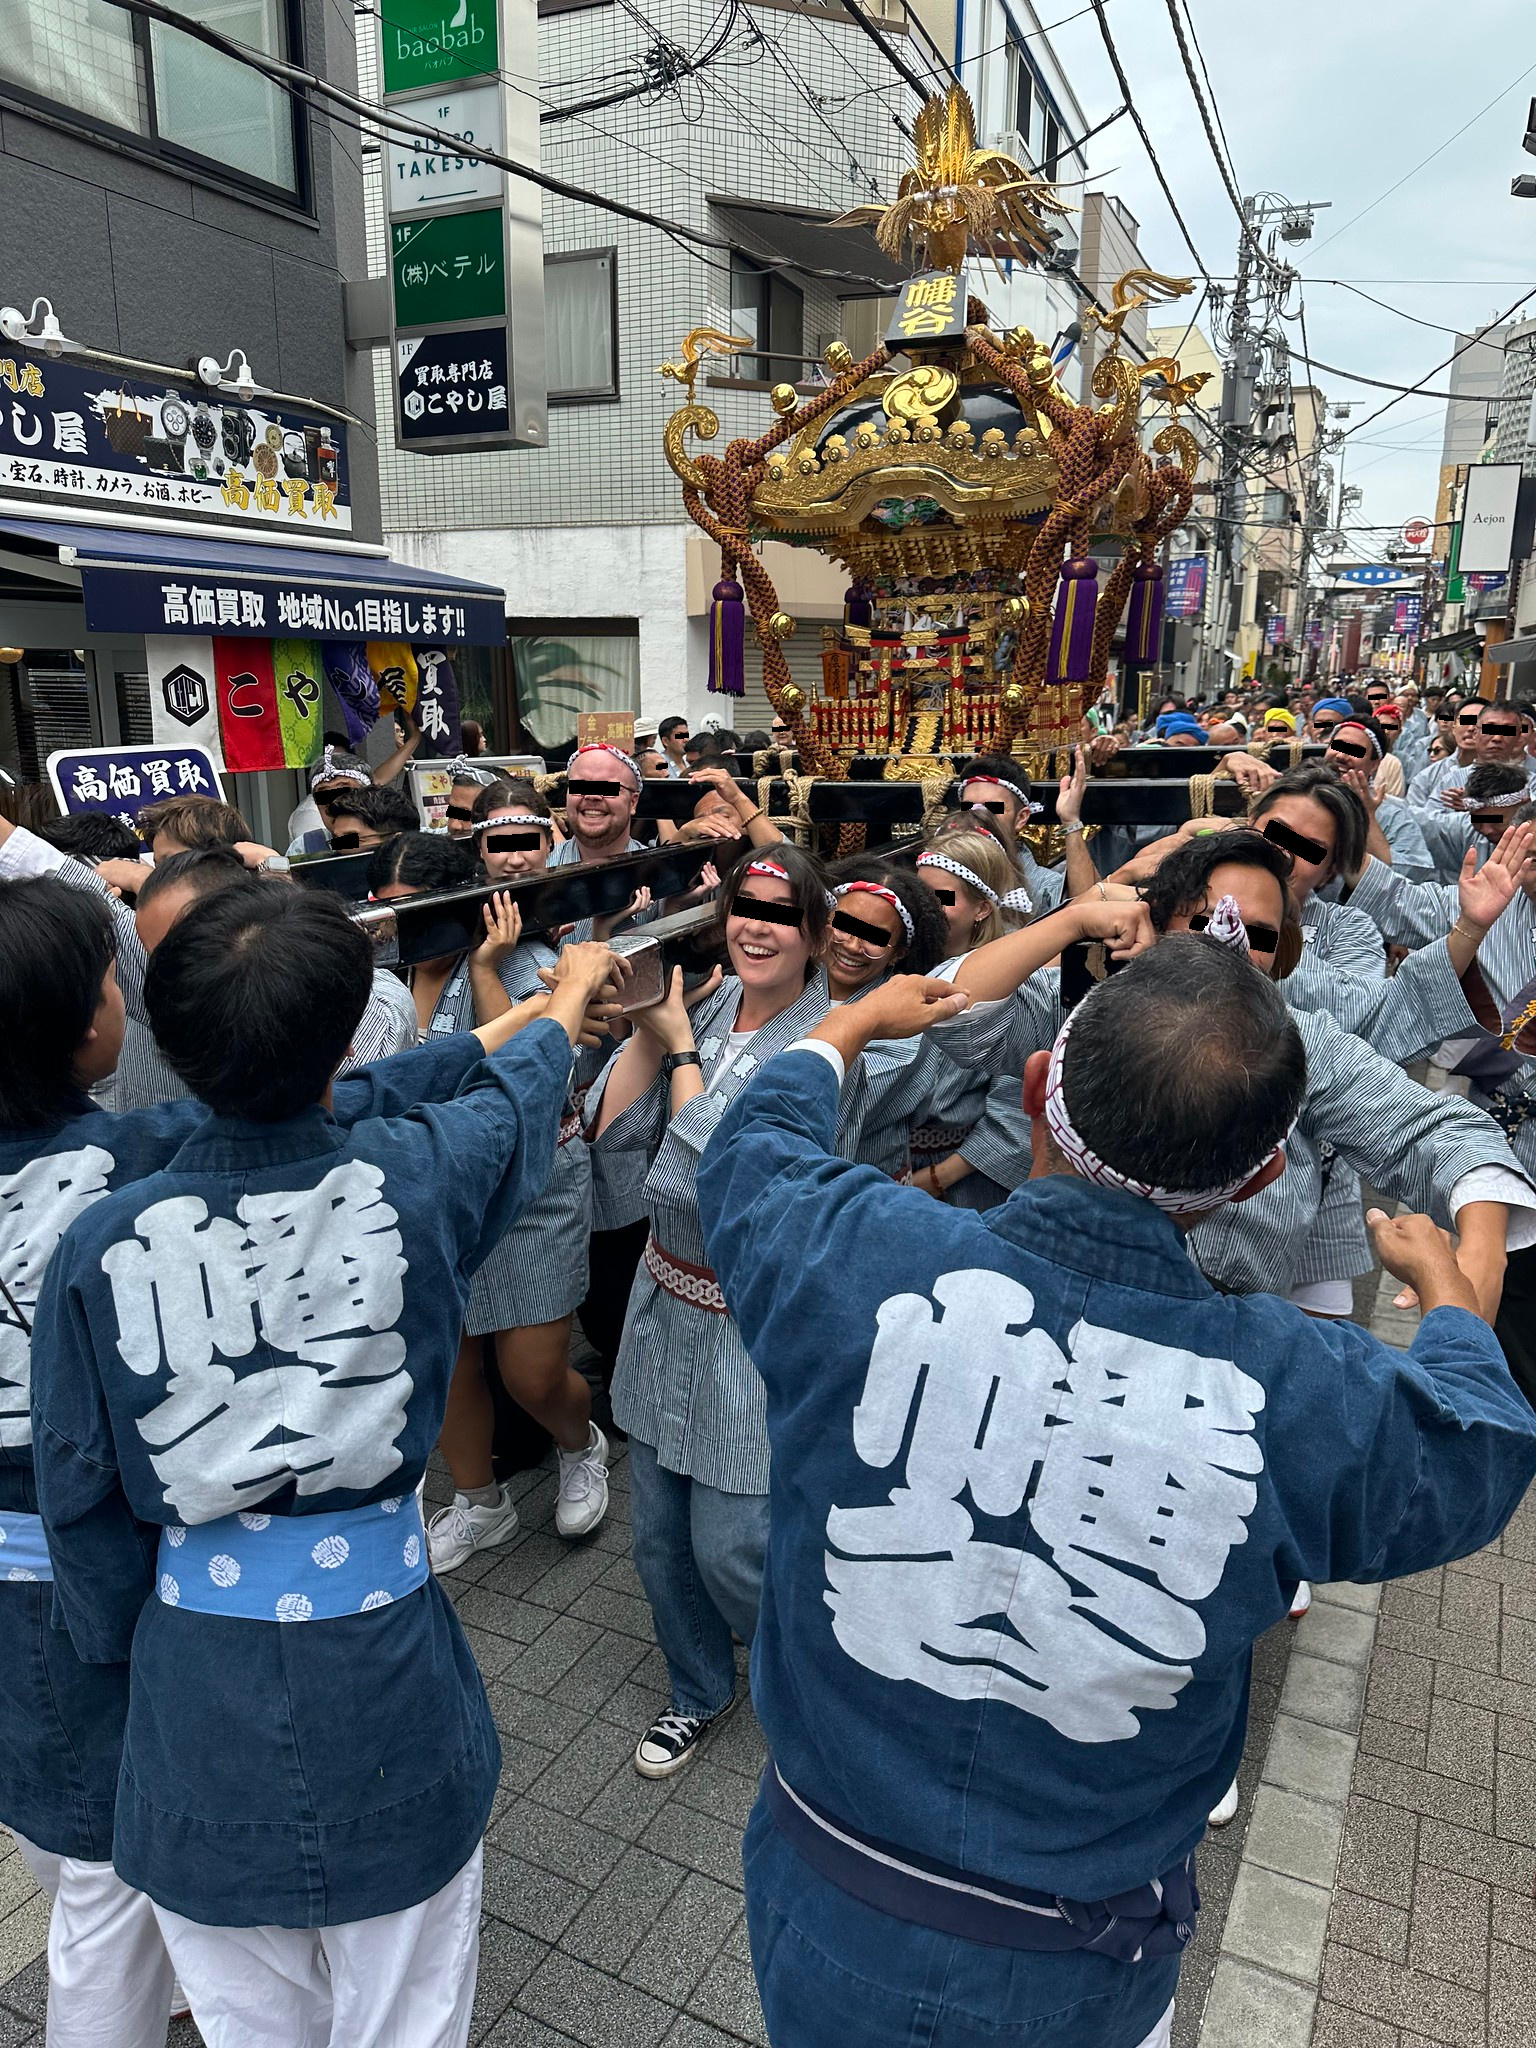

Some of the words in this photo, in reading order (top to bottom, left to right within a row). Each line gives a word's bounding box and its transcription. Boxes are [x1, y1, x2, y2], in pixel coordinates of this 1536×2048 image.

[397, 12, 485, 60] baobab
[418, 22, 439, 33] SALON
[438, 106, 450, 119] 1F
[414, 130, 474, 154] BISO
[396, 226, 412, 243] 1F
[401, 253, 496, 288] (株)ベテル
[401, 343, 413, 356] 1F
[414, 359, 494, 387] 買取専門店
[427, 385, 508, 414] こやし屋
[0, 401, 89, 456] し屋
[220, 467, 338, 522] 高価買取
[1472, 512, 1505, 526] Aejon
[161, 583, 266, 628] 高価買取
[416, 650, 451, 741] 買取
[72, 758, 209, 803] 高価買取
